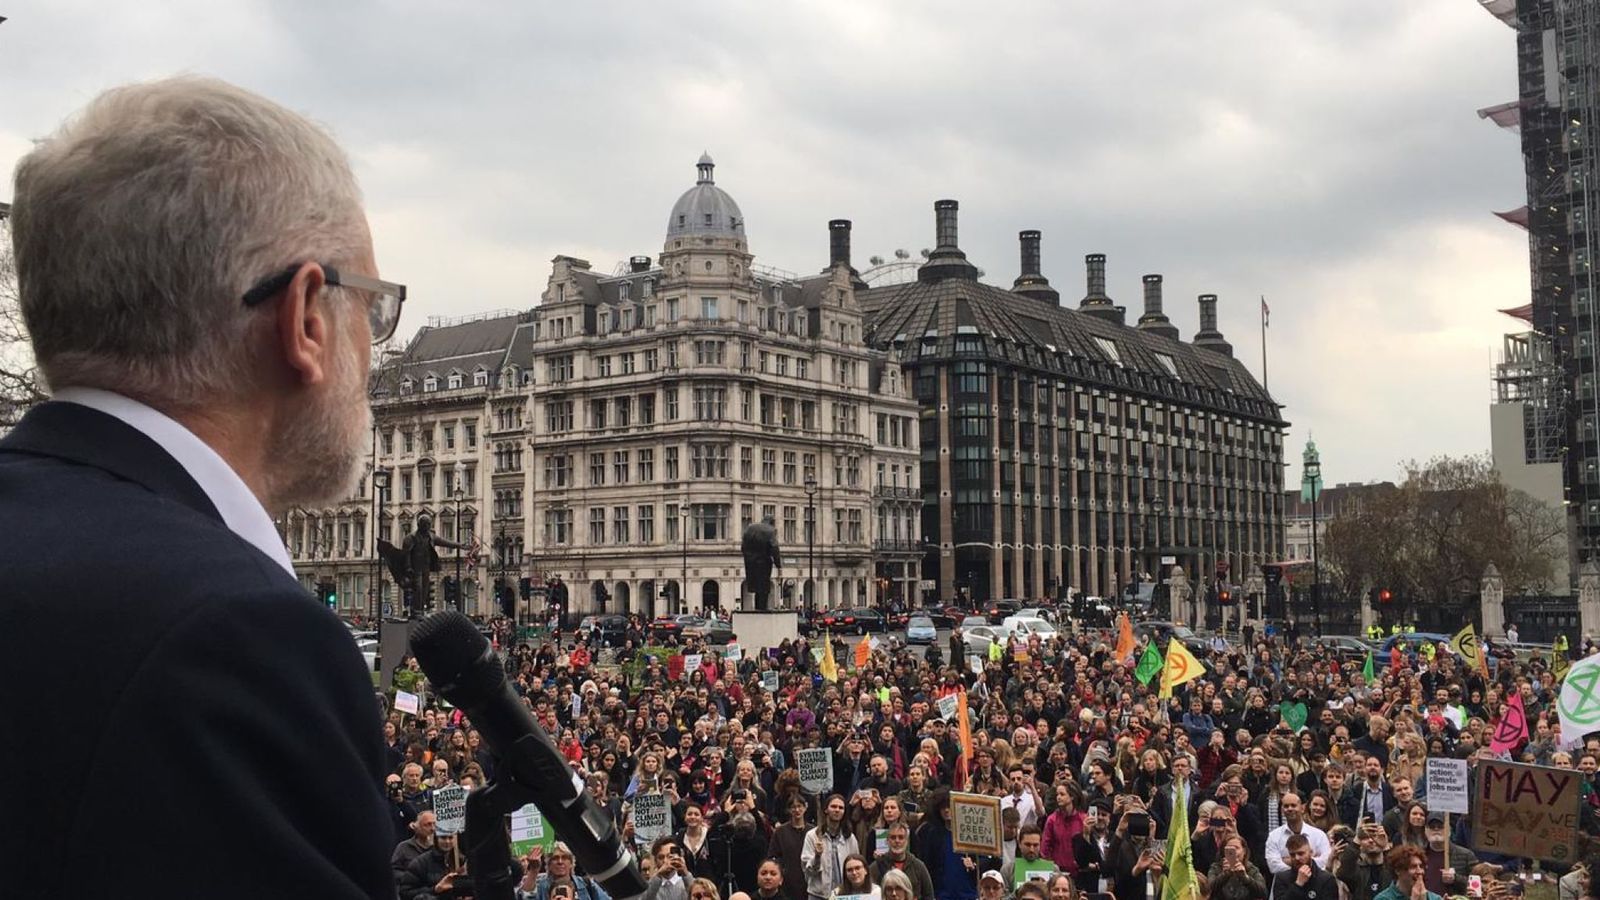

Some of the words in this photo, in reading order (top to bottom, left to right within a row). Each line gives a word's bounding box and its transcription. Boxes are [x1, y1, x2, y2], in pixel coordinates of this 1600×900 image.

[1429, 760, 1458, 769] Climate
[1430, 775, 1457, 784] climate
[1429, 783, 1445, 792] jobs
[1446, 784, 1465, 792] now!
[1484, 765, 1570, 806] MAY
[435, 794, 465, 803] CHANGE
[635, 800, 665, 808] CHANGE
[961, 806, 987, 816] SAVE
[526, 817, 539, 826] NEW
[635, 813, 667, 821] CLIMATE
[964, 815, 985, 824] OUR
[1481, 801, 1545, 833] DAY
[1548, 812, 1577, 828] WE
[526, 829, 541, 838] DEAL
[960, 824, 992, 835] GREEN
[960, 833, 992, 844] EARTH
